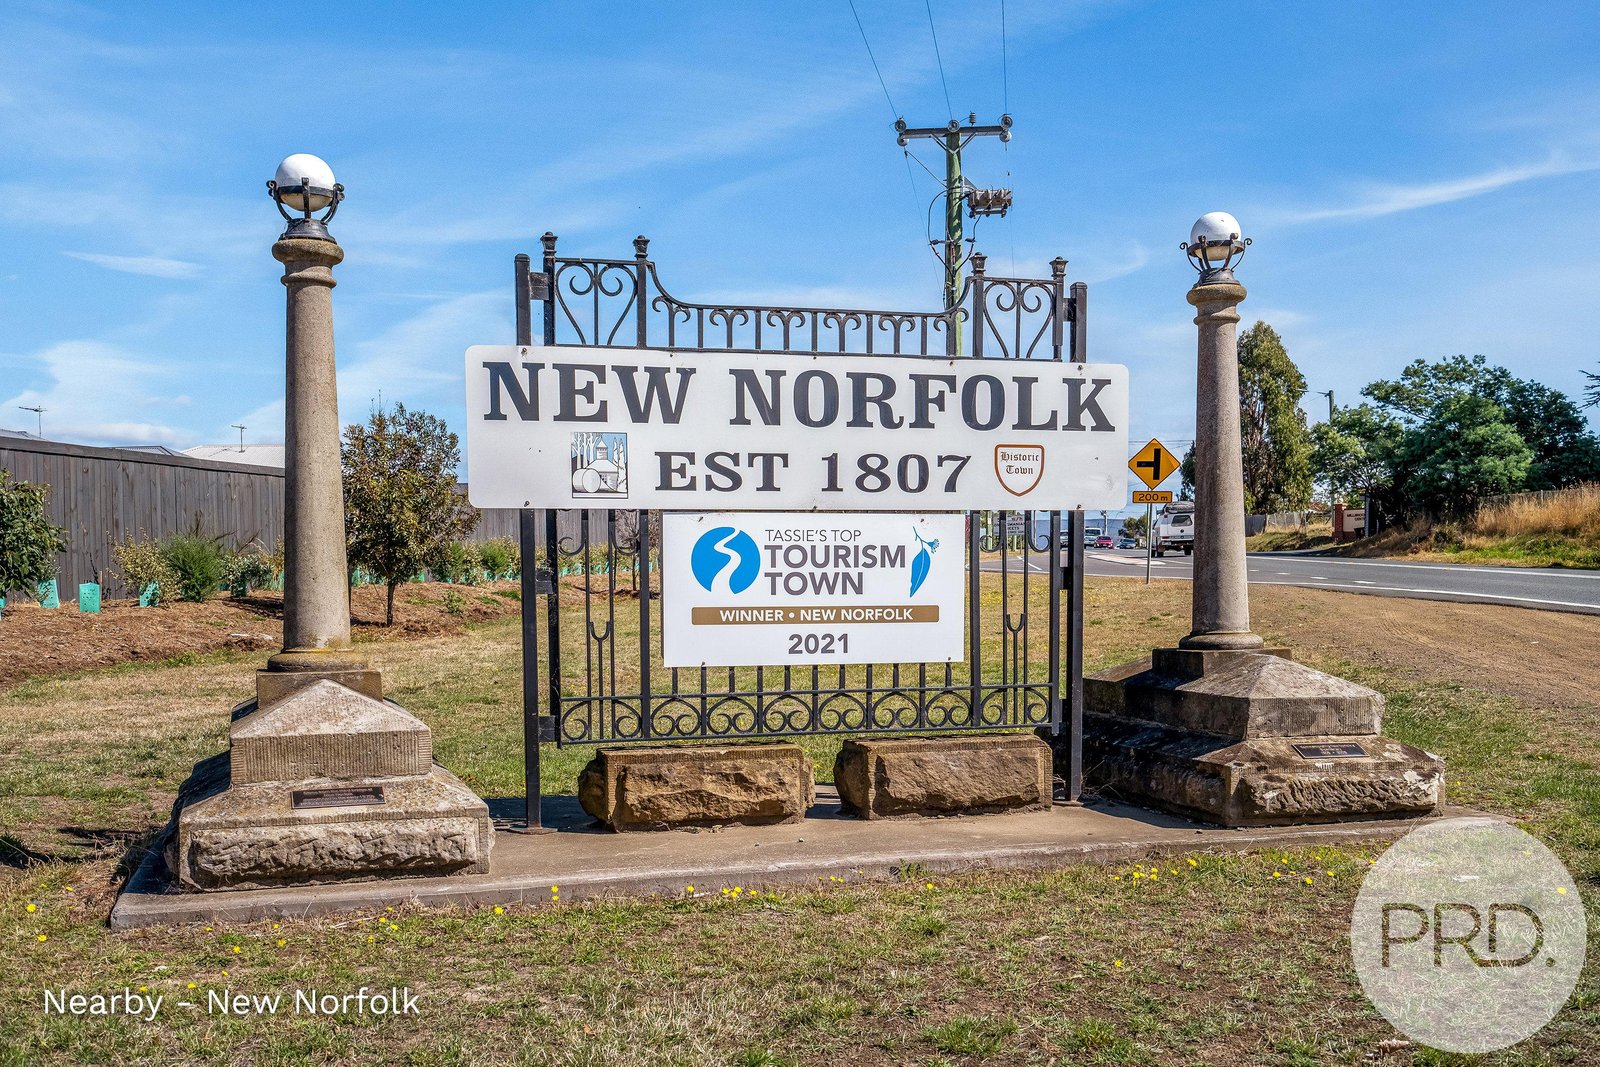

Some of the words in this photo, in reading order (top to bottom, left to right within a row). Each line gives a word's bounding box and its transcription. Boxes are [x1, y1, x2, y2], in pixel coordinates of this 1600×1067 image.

[483, 362, 696, 423] NEW
[729, 366, 1115, 431] NORFOLK
[1000, 450, 1040, 464] Historic
[655, 452, 788, 491] EST
[822, 453, 971, 493] 1807
[1004, 464, 1035, 475] Town
[1138, 493, 1159, 502] 200
[765, 529, 828, 542] TASSIE'S
[831, 530, 862, 542] TOP
[764, 545, 906, 568] TOURISM
[764, 572, 864, 595] TOWN
[720, 609, 784, 622] WINNER
[800, 609, 836, 621] NEW
[841, 608, 913, 621] NORFOLK
[788, 633, 849, 655] 2021
